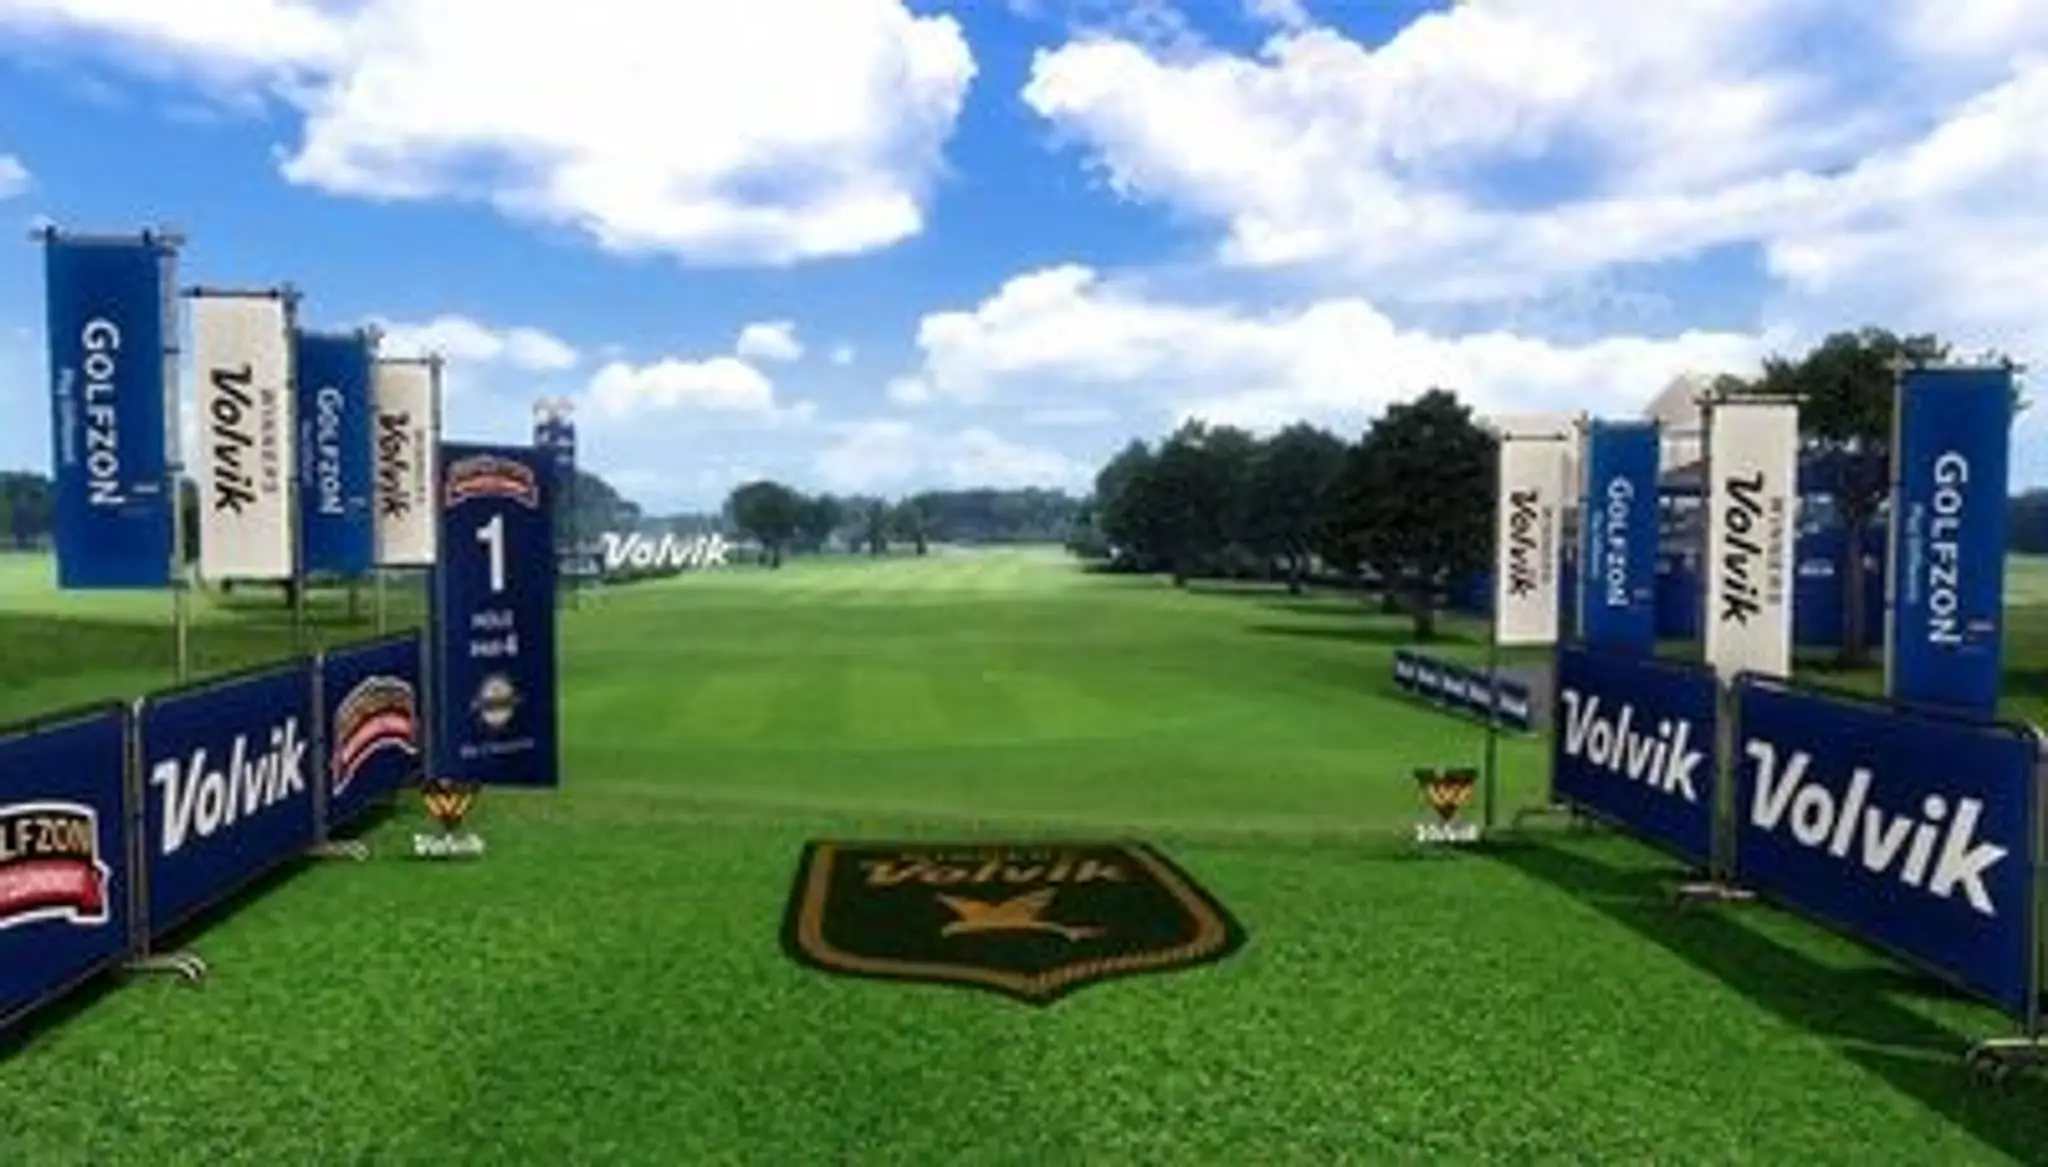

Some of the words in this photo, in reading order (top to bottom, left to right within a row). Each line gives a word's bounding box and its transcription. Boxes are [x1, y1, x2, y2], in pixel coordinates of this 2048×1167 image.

[82, 317, 125, 504] GOLFZON
[210, 363, 257, 513] Volvik
[317, 387, 344, 513] GOLFZON
[380, 411, 410, 520] Volvik
[475, 514, 504, 592] 1
[601, 530, 729, 568] Volvik
[1510, 489, 1538, 599] Volvik
[1607, 476, 1634, 606] GOLFZON
[1721, 470, 1763, 626] Volvik
[1929, 452, 1968, 642] GOLFZON
[150, 716, 306, 855] Volvik
[1562, 688, 1702, 804] Volvik
[861, 858, 1124, 884] Volvik
[1746, 738, 2009, 917] Volvik
